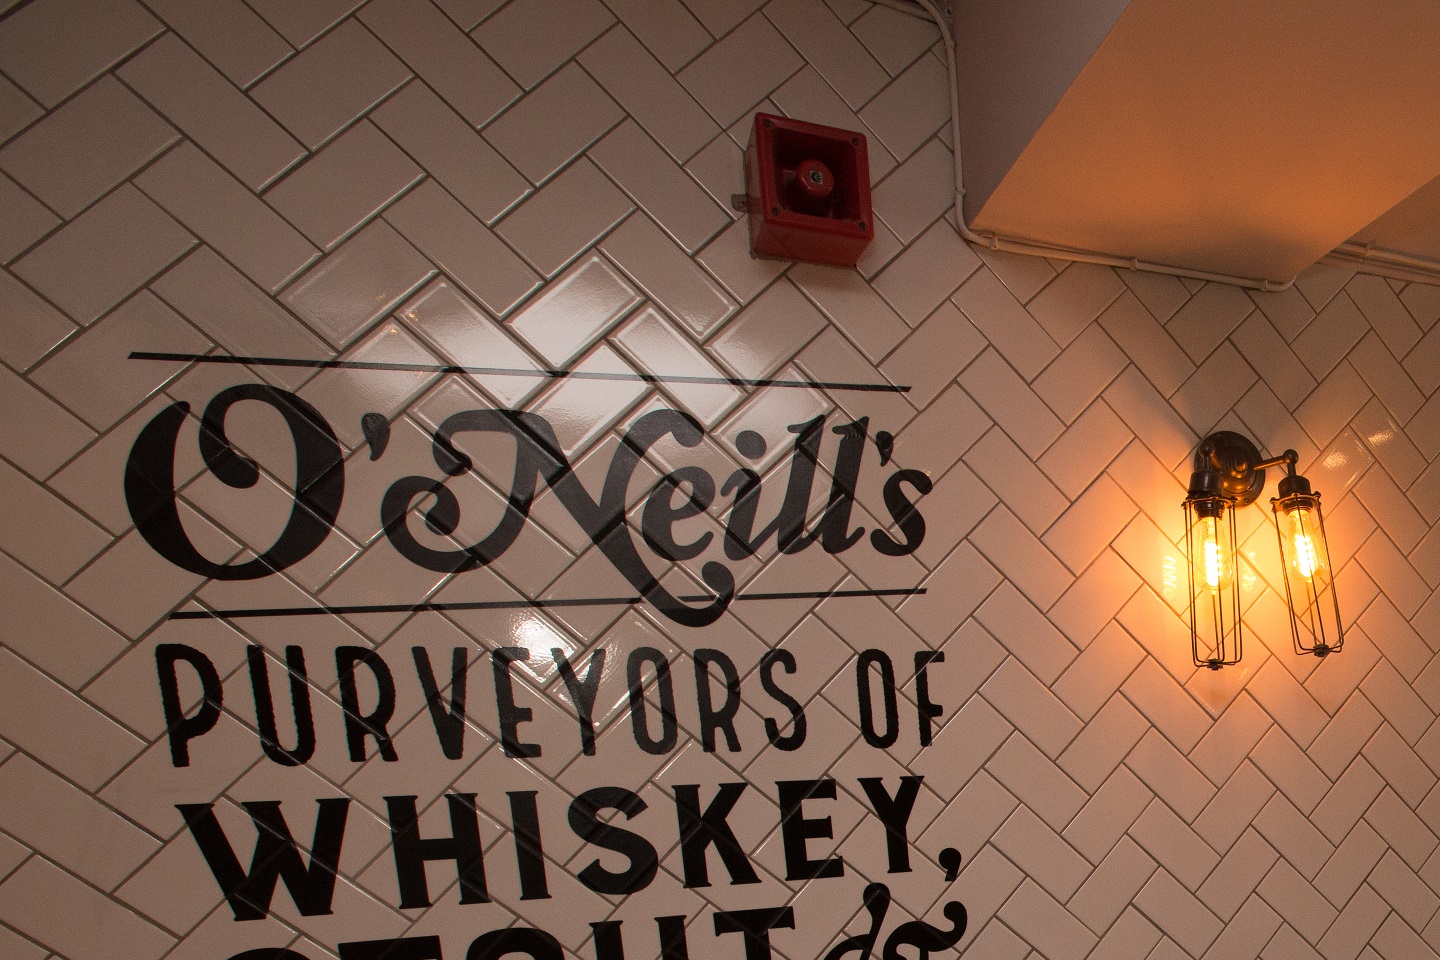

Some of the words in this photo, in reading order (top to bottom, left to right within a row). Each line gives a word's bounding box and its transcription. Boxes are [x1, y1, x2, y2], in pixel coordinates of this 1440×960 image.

[124, 384, 933, 627] O'Neill's
[155, 643, 806, 767] PURVEYORS
[857, 648, 945, 747] OF
[174, 775, 963, 921] WHISKEY,
